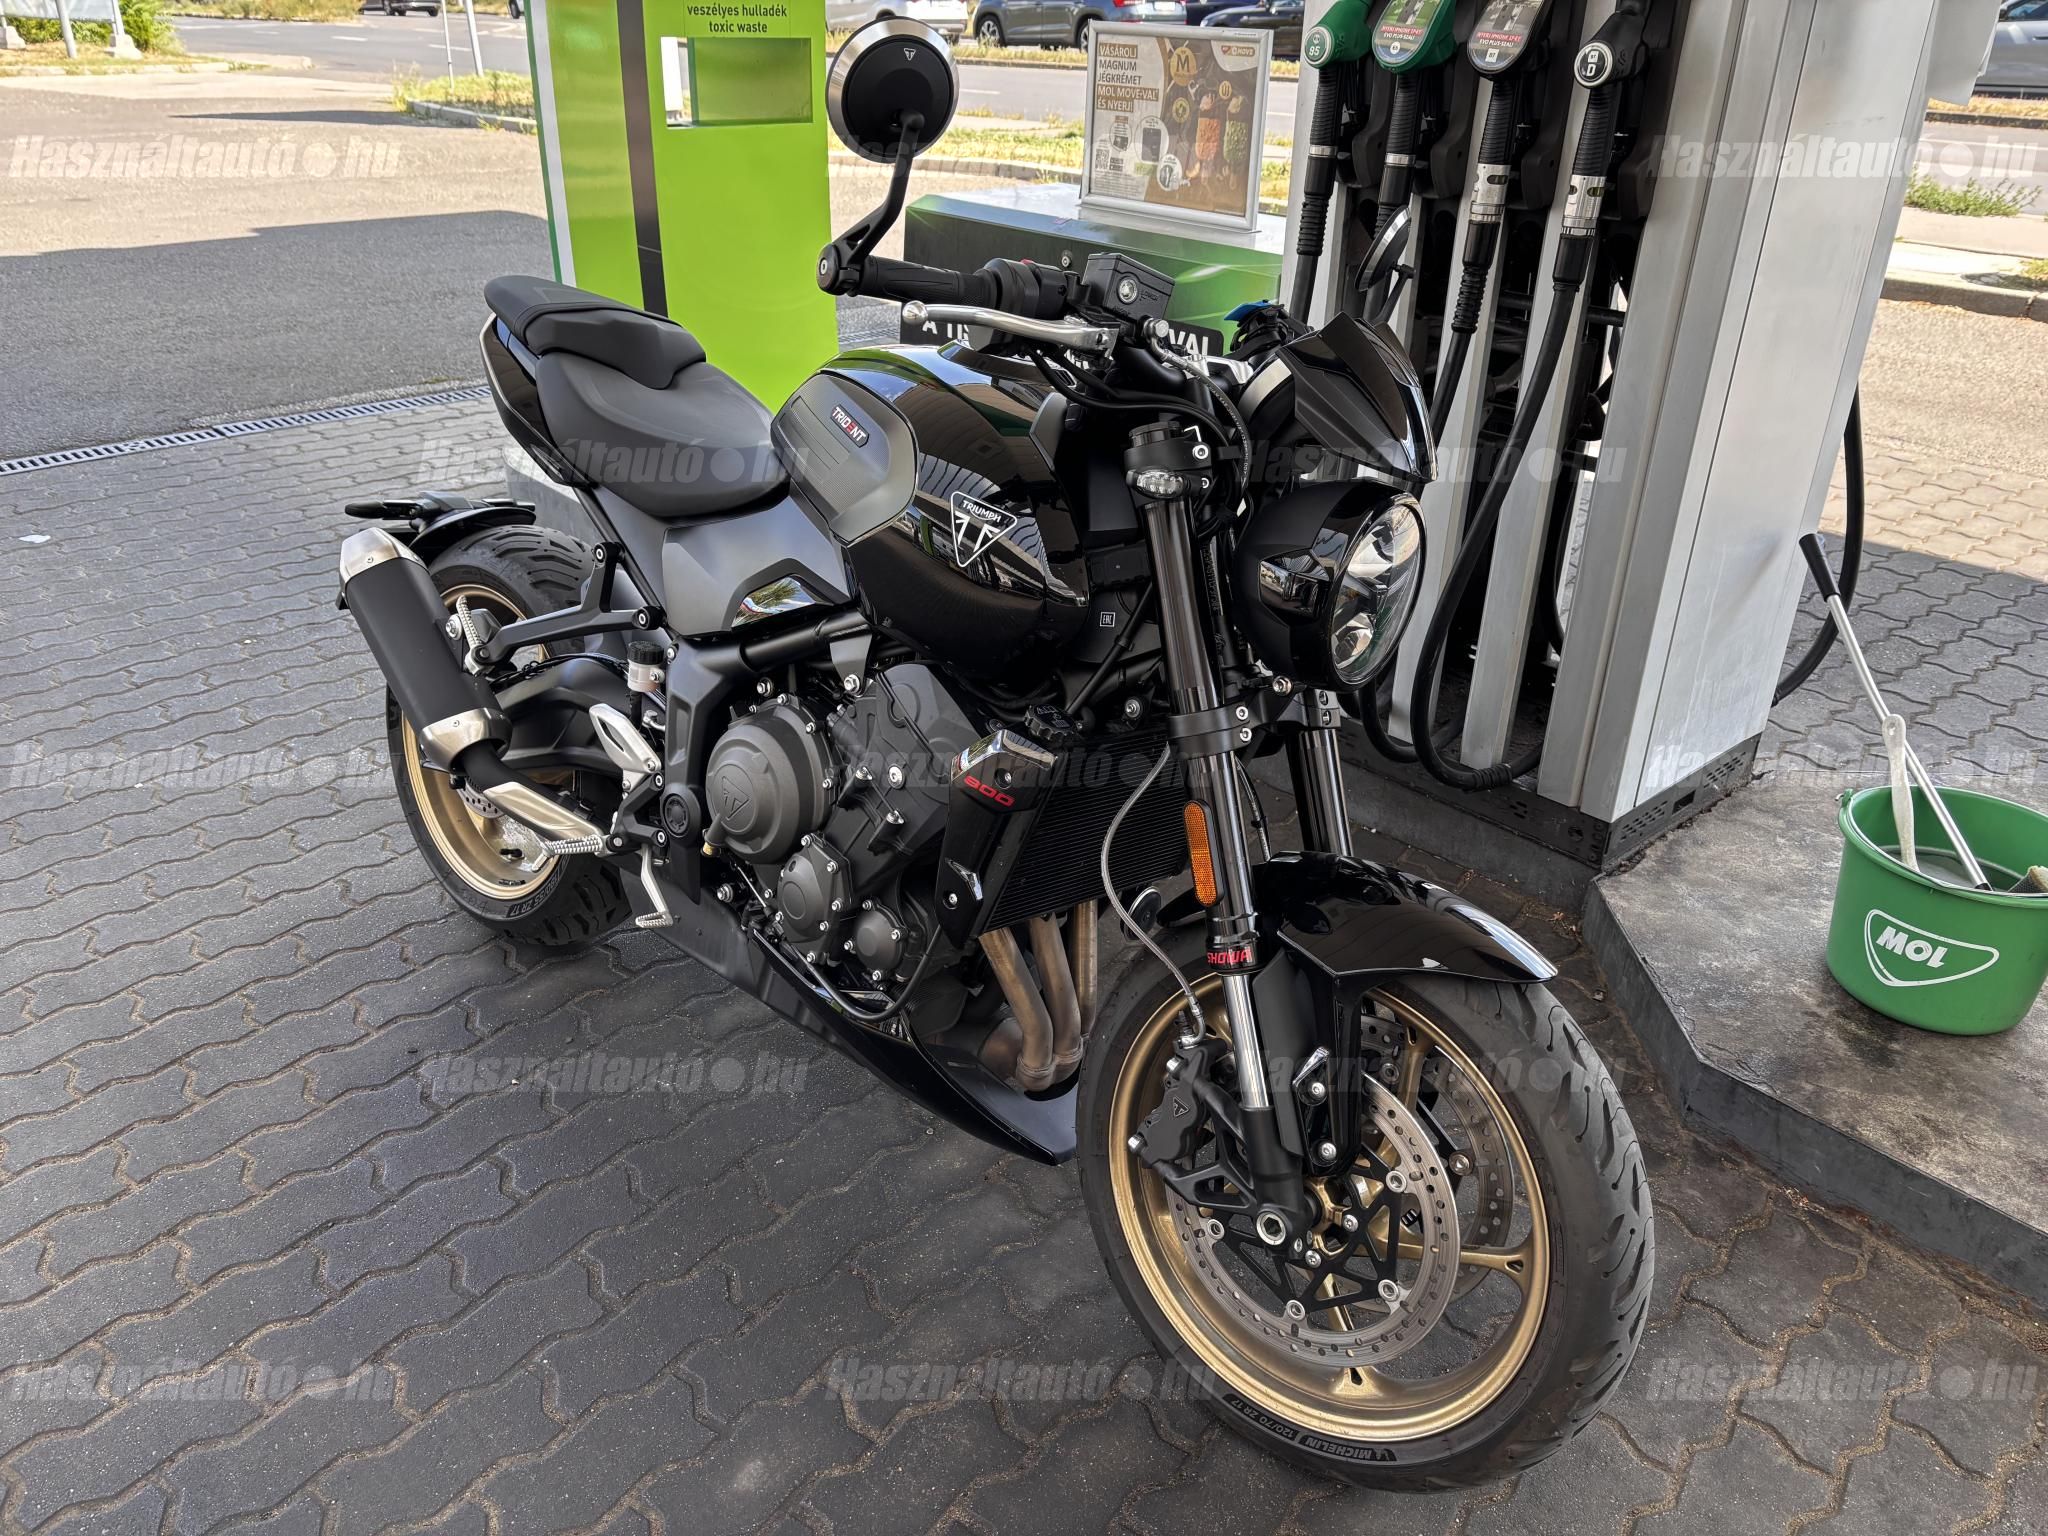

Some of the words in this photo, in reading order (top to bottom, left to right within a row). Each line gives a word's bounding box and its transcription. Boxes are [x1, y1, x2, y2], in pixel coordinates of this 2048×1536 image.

[686, 5, 739, 18] veszélyes
[742, 4, 787, 17] hulladék
[709, 21, 734, 33] toxic
[736, 22, 768, 33] waste
[1308, 46, 1321, 56] 95
[1098, 59, 1137, 71] MAGNUM
[1176, 52, 1190, 73] M
[1586, 63, 1597, 77] D
[1098, 70, 1142, 85] JÉGKRÉMET
[1097, 86, 1115, 97] MOL
[832, 406, 867, 442] TRIDENT
[963, 499, 1002, 523] TRIUMPH
[1875, 925, 1949, 969] MOL
[1207, 946, 1253, 966] SHOWA
[1231, 1397, 1244, 1411] 17
[1243, 1406, 1259, 1420] ZR
[1259, 1415, 1295, 1439] 120/70
[1305, 1436, 1371, 1461] MICHELIN
